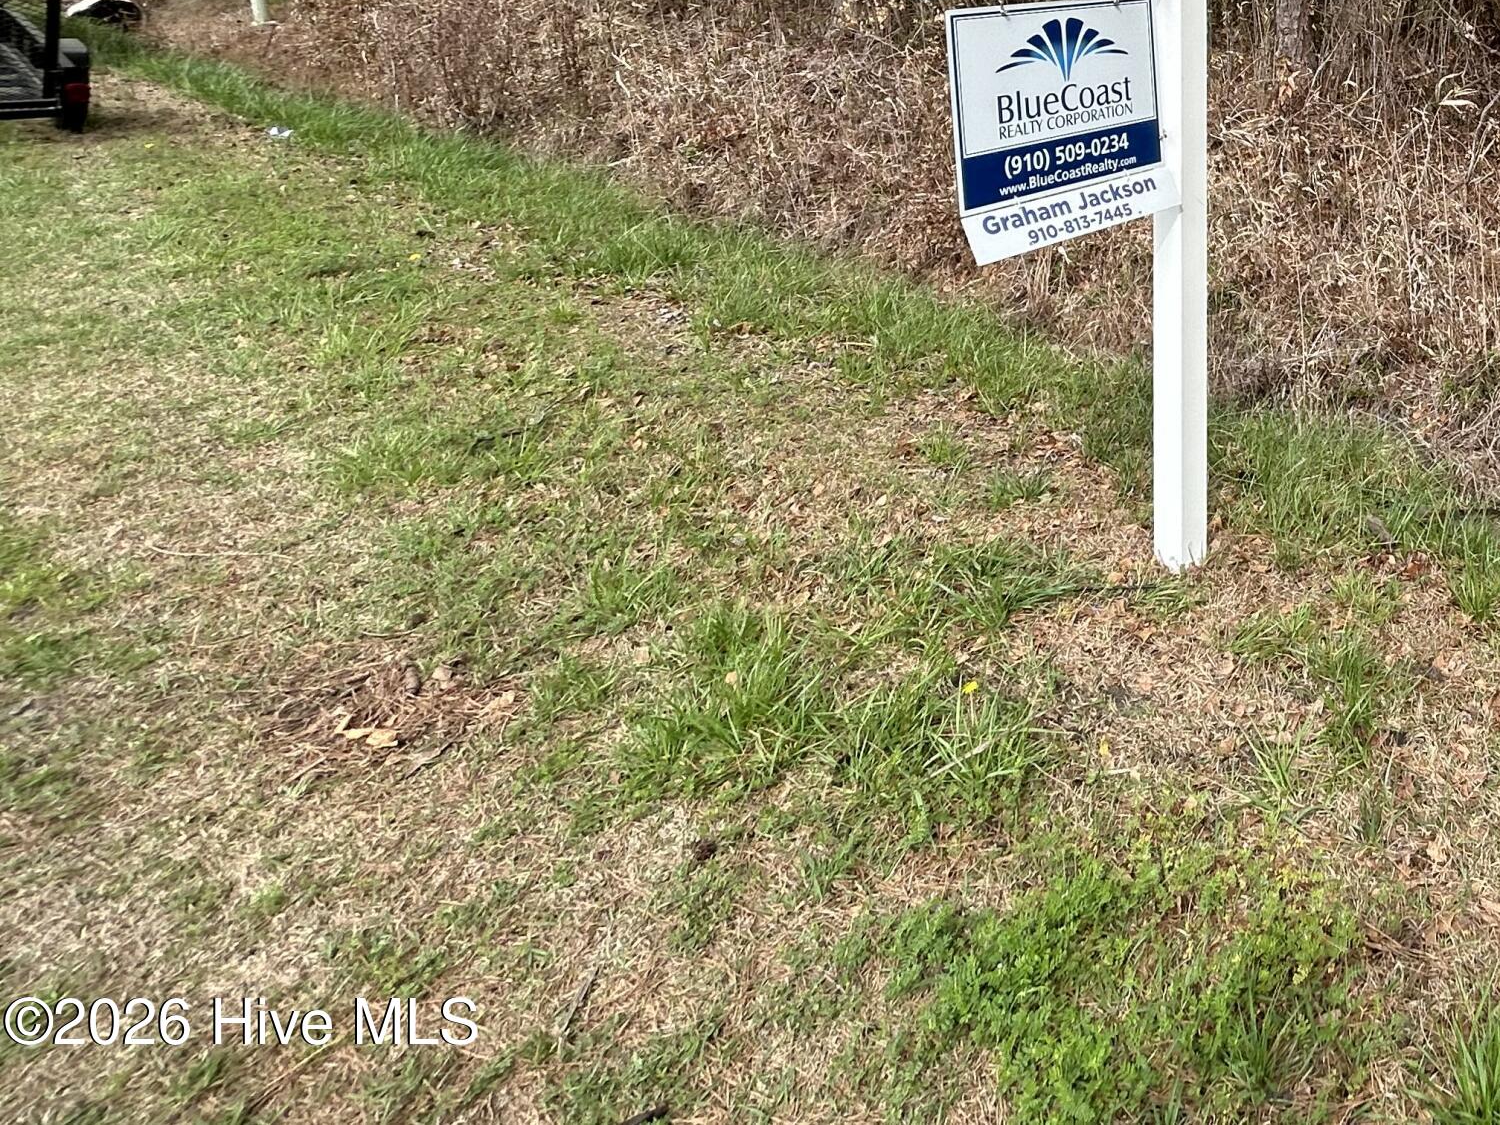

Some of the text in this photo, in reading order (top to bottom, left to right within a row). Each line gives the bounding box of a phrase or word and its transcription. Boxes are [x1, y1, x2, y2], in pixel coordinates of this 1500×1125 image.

[997, 76, 1132, 125] BlueCoast
[999, 103, 1133, 140] REALTY CORPORATION
[999, 155, 1137, 197] www.BlueCoastRealty.com
[1004, 132, 1130, 179] (910) 509-0234
[982, 176, 1157, 235] Graham Jackson
[1028, 203, 1133, 245] 910-813-7445
